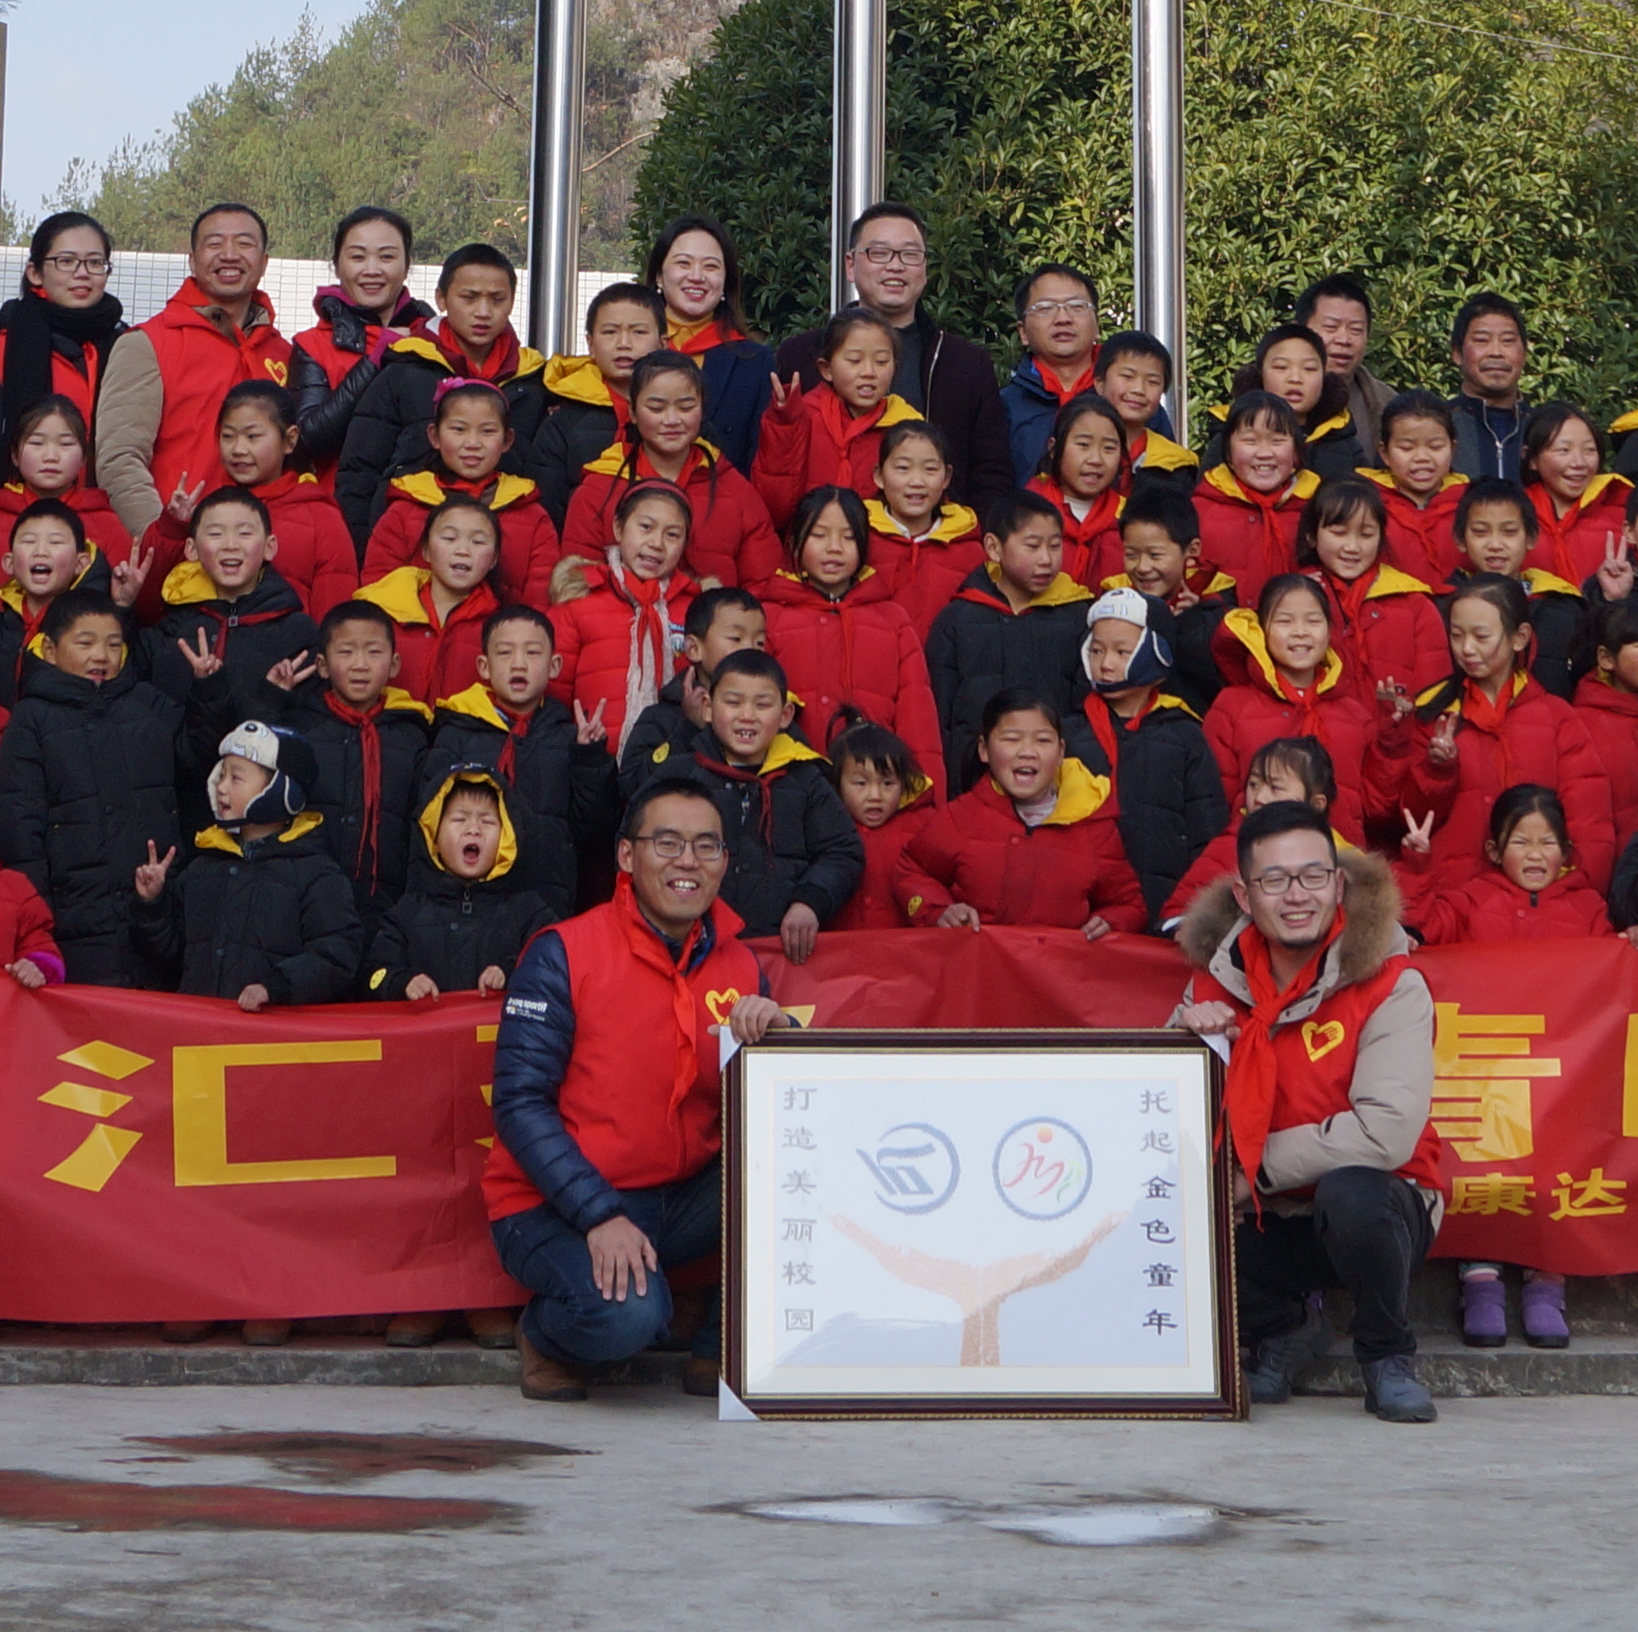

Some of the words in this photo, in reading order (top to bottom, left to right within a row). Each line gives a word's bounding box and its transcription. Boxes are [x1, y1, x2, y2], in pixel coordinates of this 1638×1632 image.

[781, 1086, 818, 1332] 打造美丽校园
[1139, 1089, 1178, 1336] 托起金色童年
